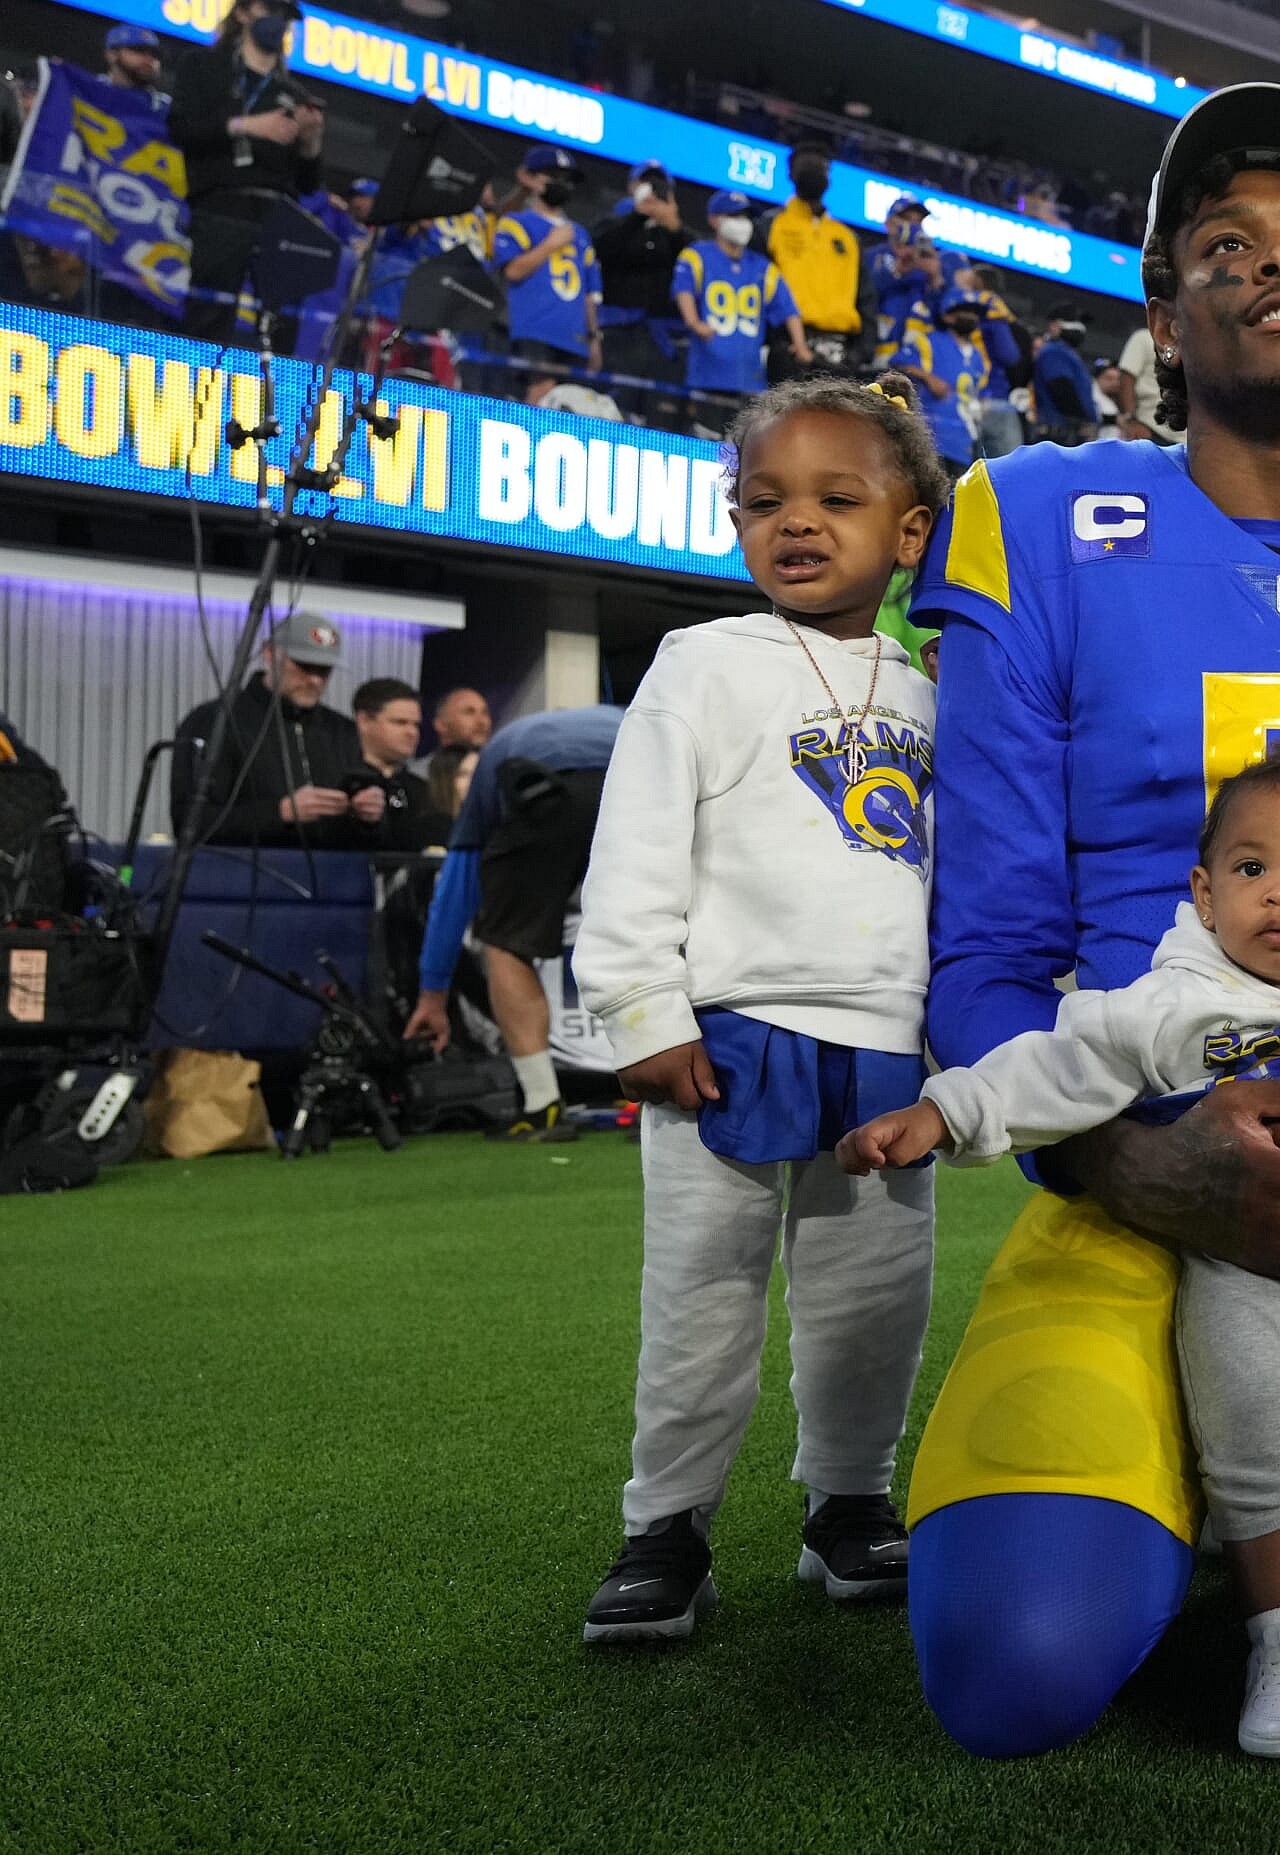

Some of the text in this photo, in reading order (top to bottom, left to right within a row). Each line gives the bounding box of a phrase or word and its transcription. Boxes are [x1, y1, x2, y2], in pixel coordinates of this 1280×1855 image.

[303, 15, 417, 92] BOWL
[423, 52, 482, 110] LVI
[486, 70, 605, 144] BOUND
[548, 245, 582, 302] 5
[706, 280, 760, 338] 99
[0, 327, 285, 486] BOWL
[479, 418, 740, 557] BOUND
[1073, 493, 1148, 542] C
[786, 721, 936, 768] RAMS
[801, 707, 842, 725] LOS
